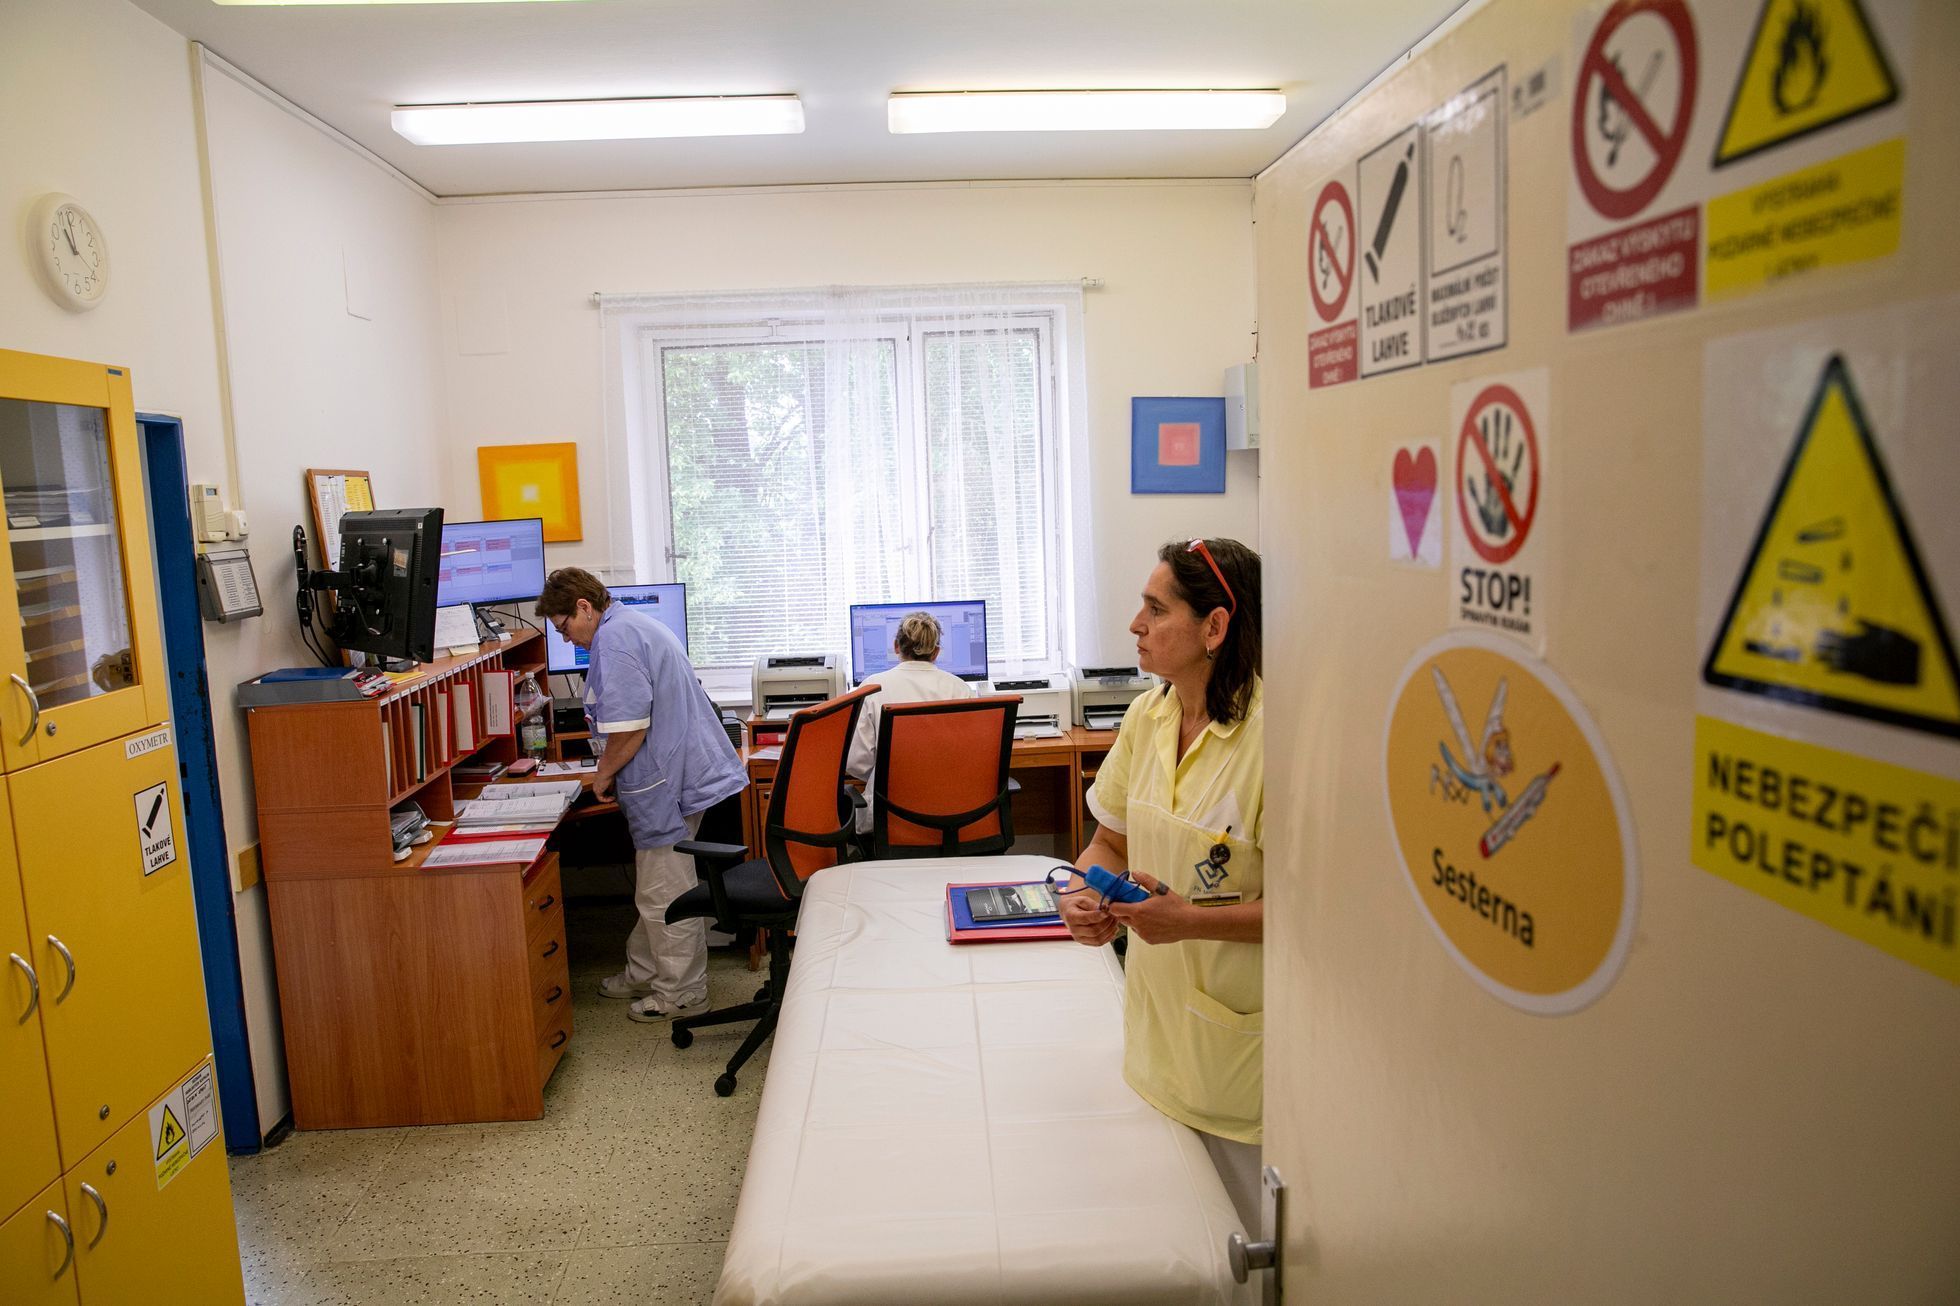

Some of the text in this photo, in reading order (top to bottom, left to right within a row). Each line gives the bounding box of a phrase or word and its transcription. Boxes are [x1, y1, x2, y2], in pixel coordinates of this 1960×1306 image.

[1366, 283, 1417, 328] TLAKOVÉ
[1372, 333, 1409, 363] LAHVE
[1461, 566, 1531, 615] STOP!
[129, 733, 169, 755] OXYMETR
[144, 834, 171, 857] TLAKOVÉ
[150, 851, 169, 868] LAHVE
[1432, 847, 1535, 949] Sesterna
[1706, 811, 1956, 950] POLEPTÁNÍ
